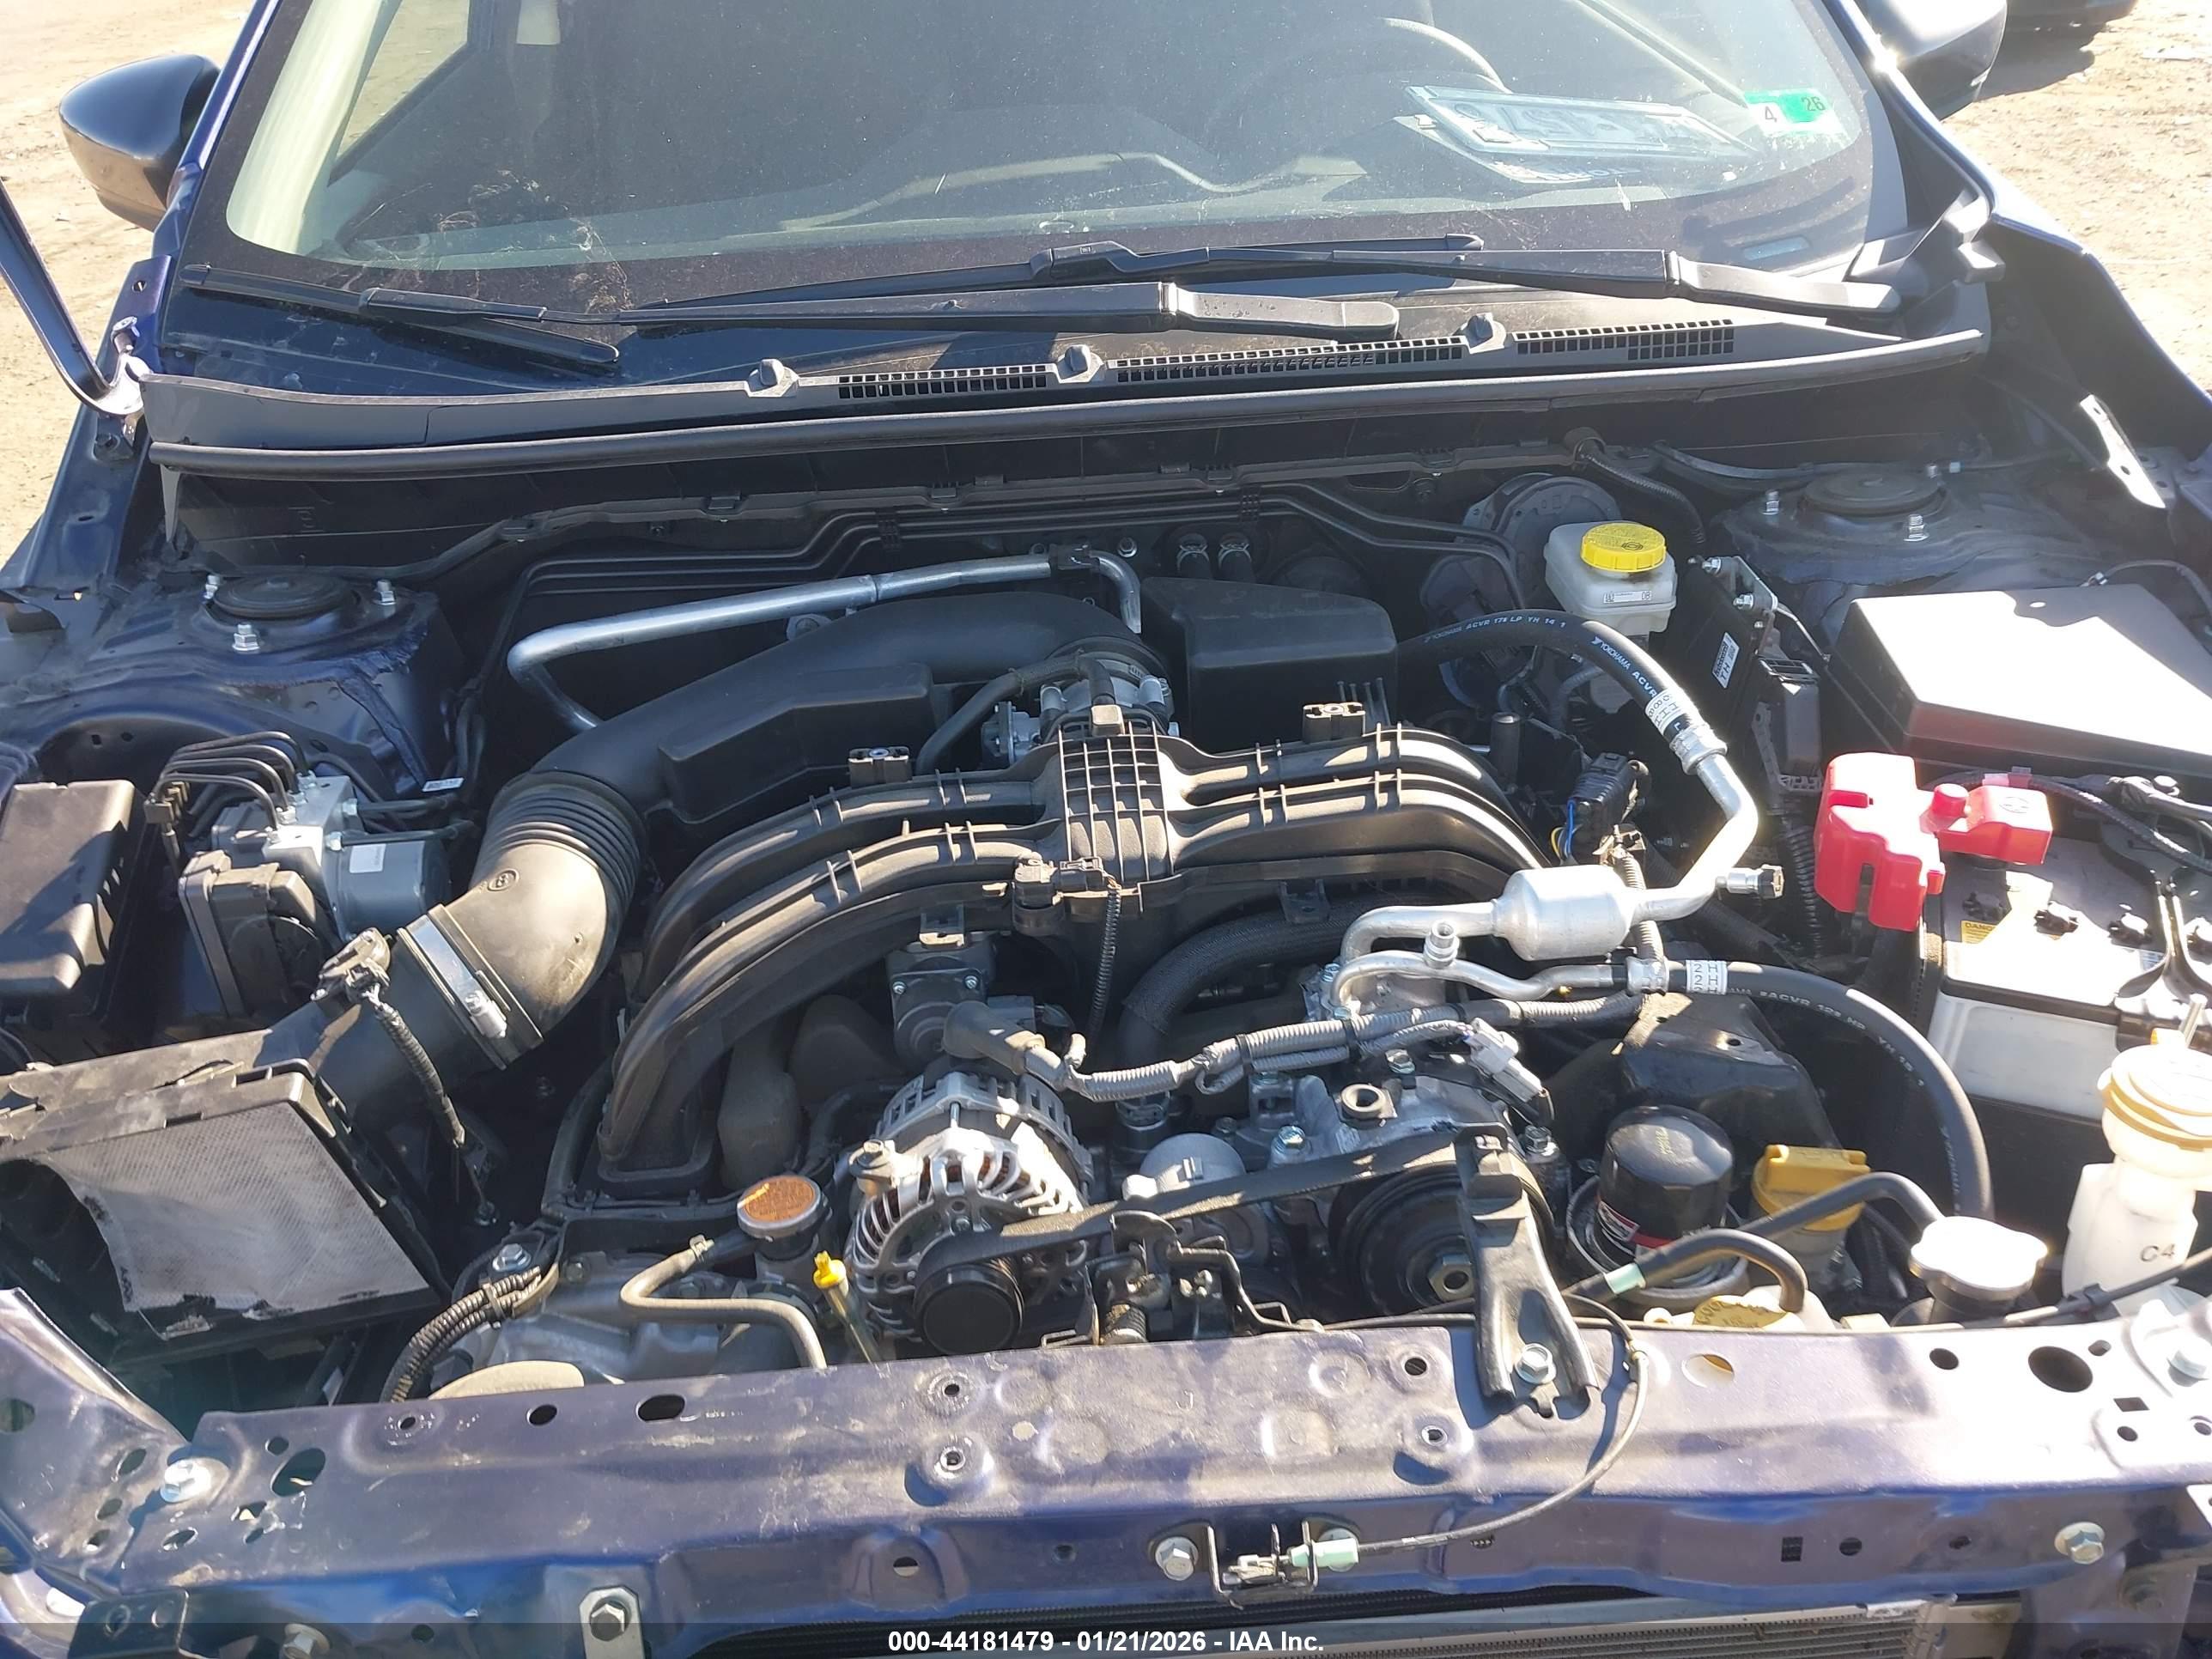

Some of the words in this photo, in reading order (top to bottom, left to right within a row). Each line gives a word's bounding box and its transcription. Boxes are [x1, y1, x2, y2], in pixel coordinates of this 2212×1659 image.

[1801, 95, 1826, 112] 26
[1765, 105, 1778, 123] 4
[1599, 641, 1632, 670] YOKOHAMA
[1632, 671, 1658, 698] ACVR
